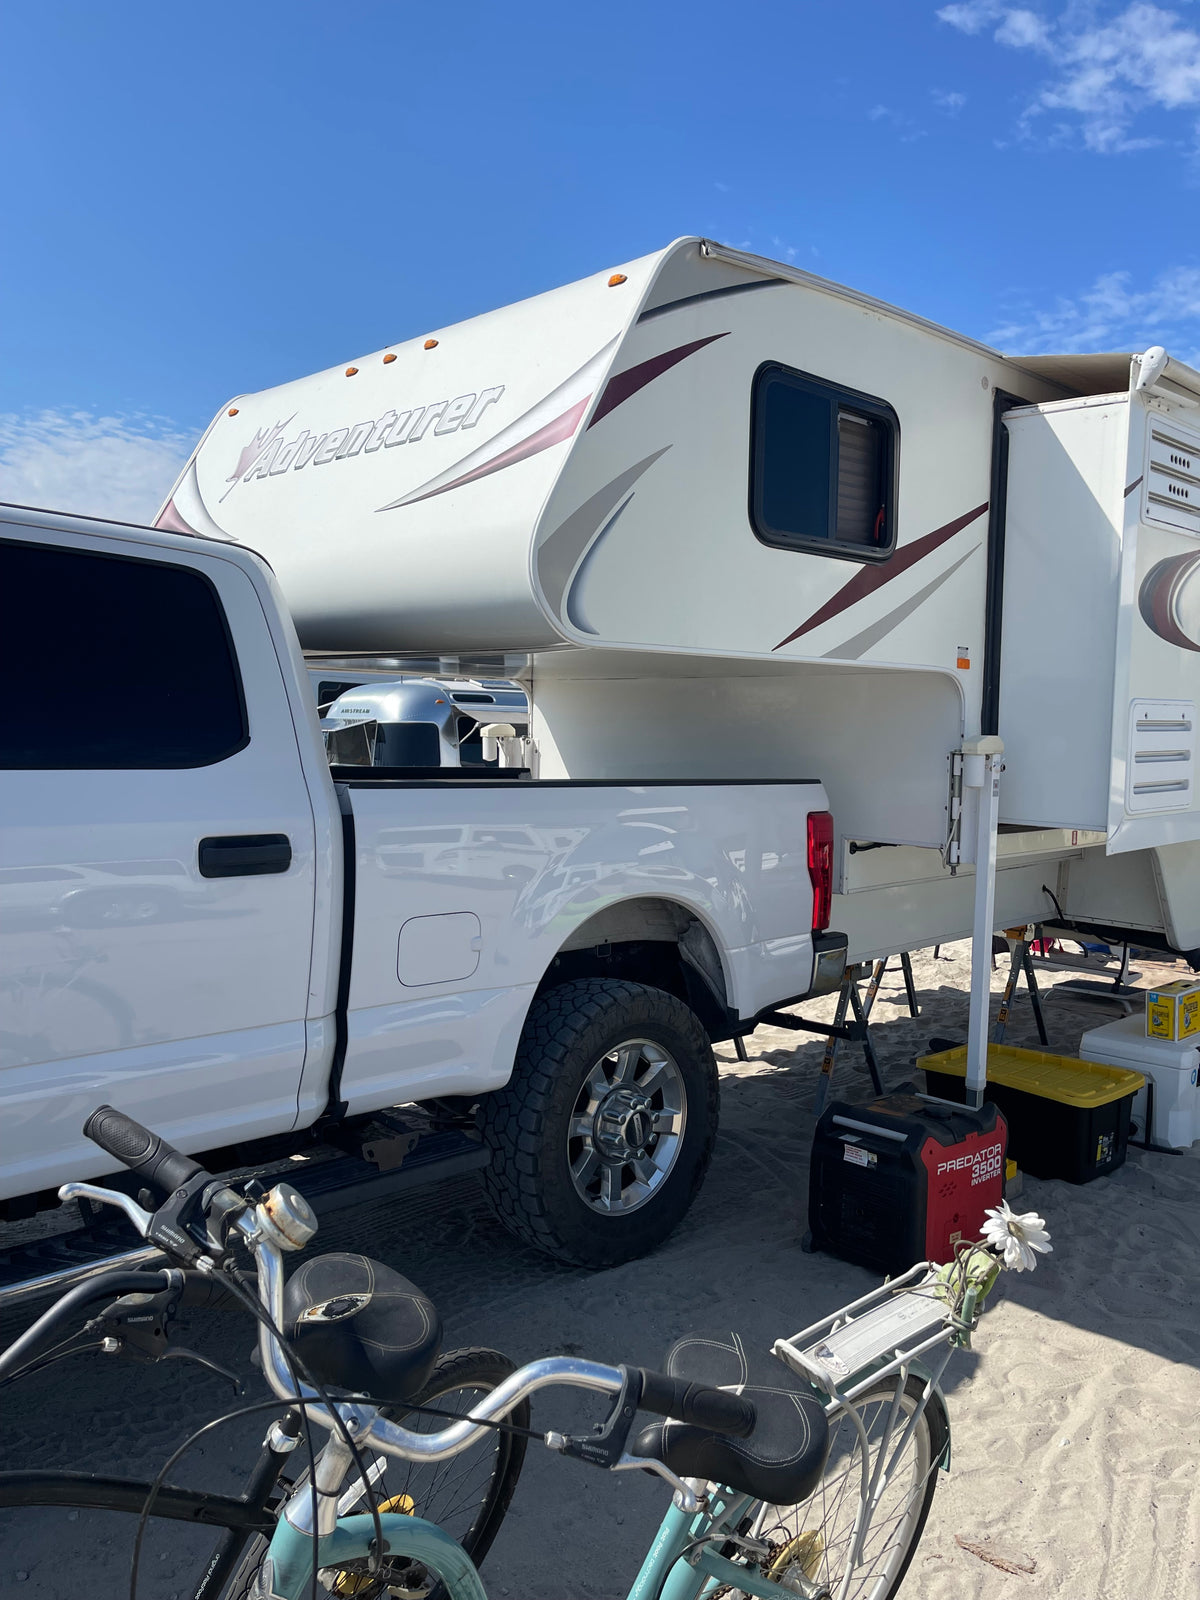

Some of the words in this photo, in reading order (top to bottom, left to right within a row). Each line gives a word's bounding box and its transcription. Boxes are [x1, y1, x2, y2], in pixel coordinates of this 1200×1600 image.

[243, 385, 505, 482] Adventurer
[937, 1143, 1002, 1176] PREDATOR
[971, 1155, 1002, 1178] 3500
[970, 1167, 1002, 1187] INVERTER
